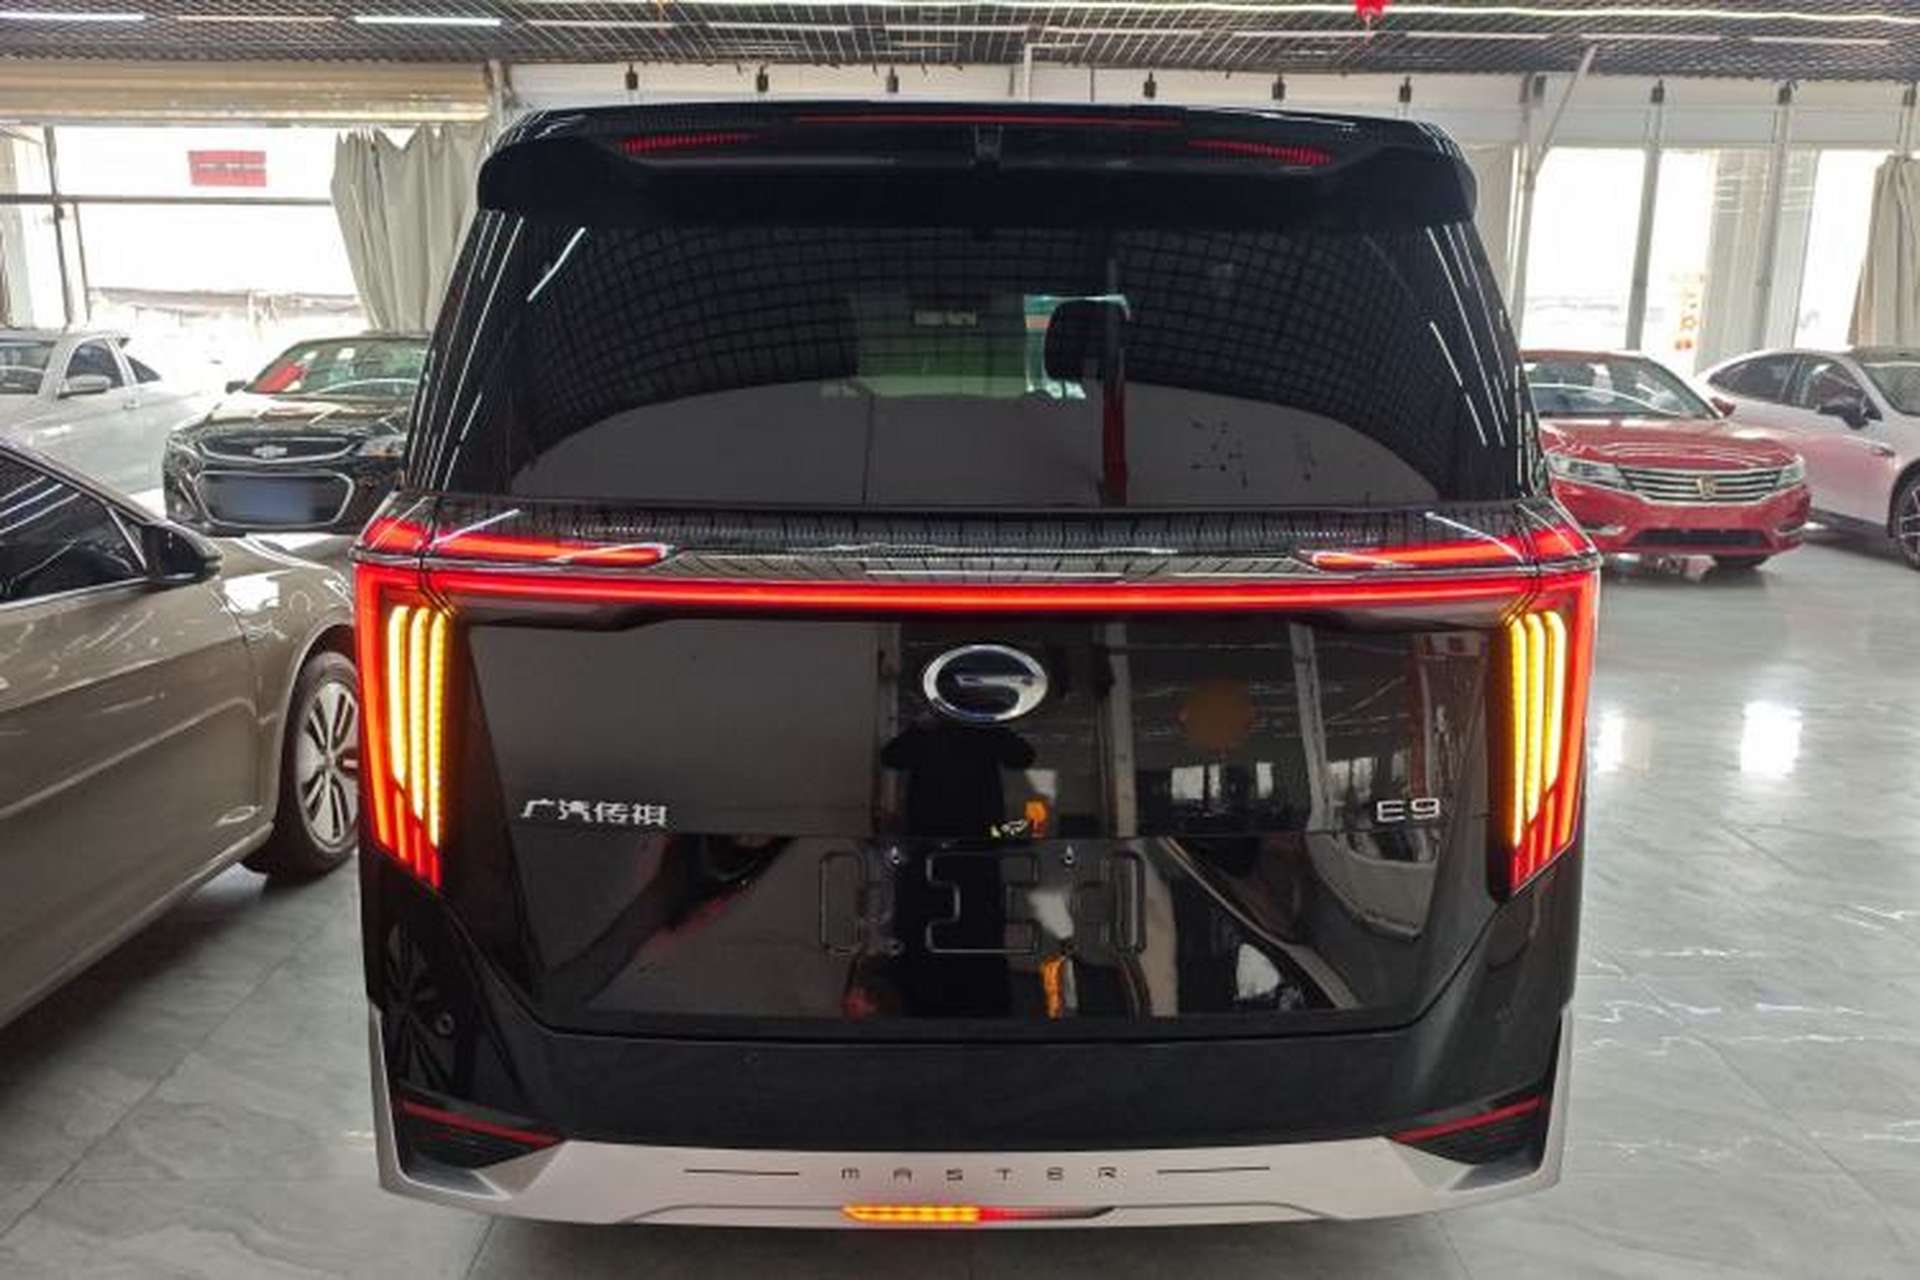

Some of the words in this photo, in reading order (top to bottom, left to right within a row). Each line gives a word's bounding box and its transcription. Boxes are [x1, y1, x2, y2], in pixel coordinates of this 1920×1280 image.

[520, 798, 668, 828] 广汽传祺
[1376, 798, 1440, 822] E9
[841, 1166, 1118, 1181] MASTER
